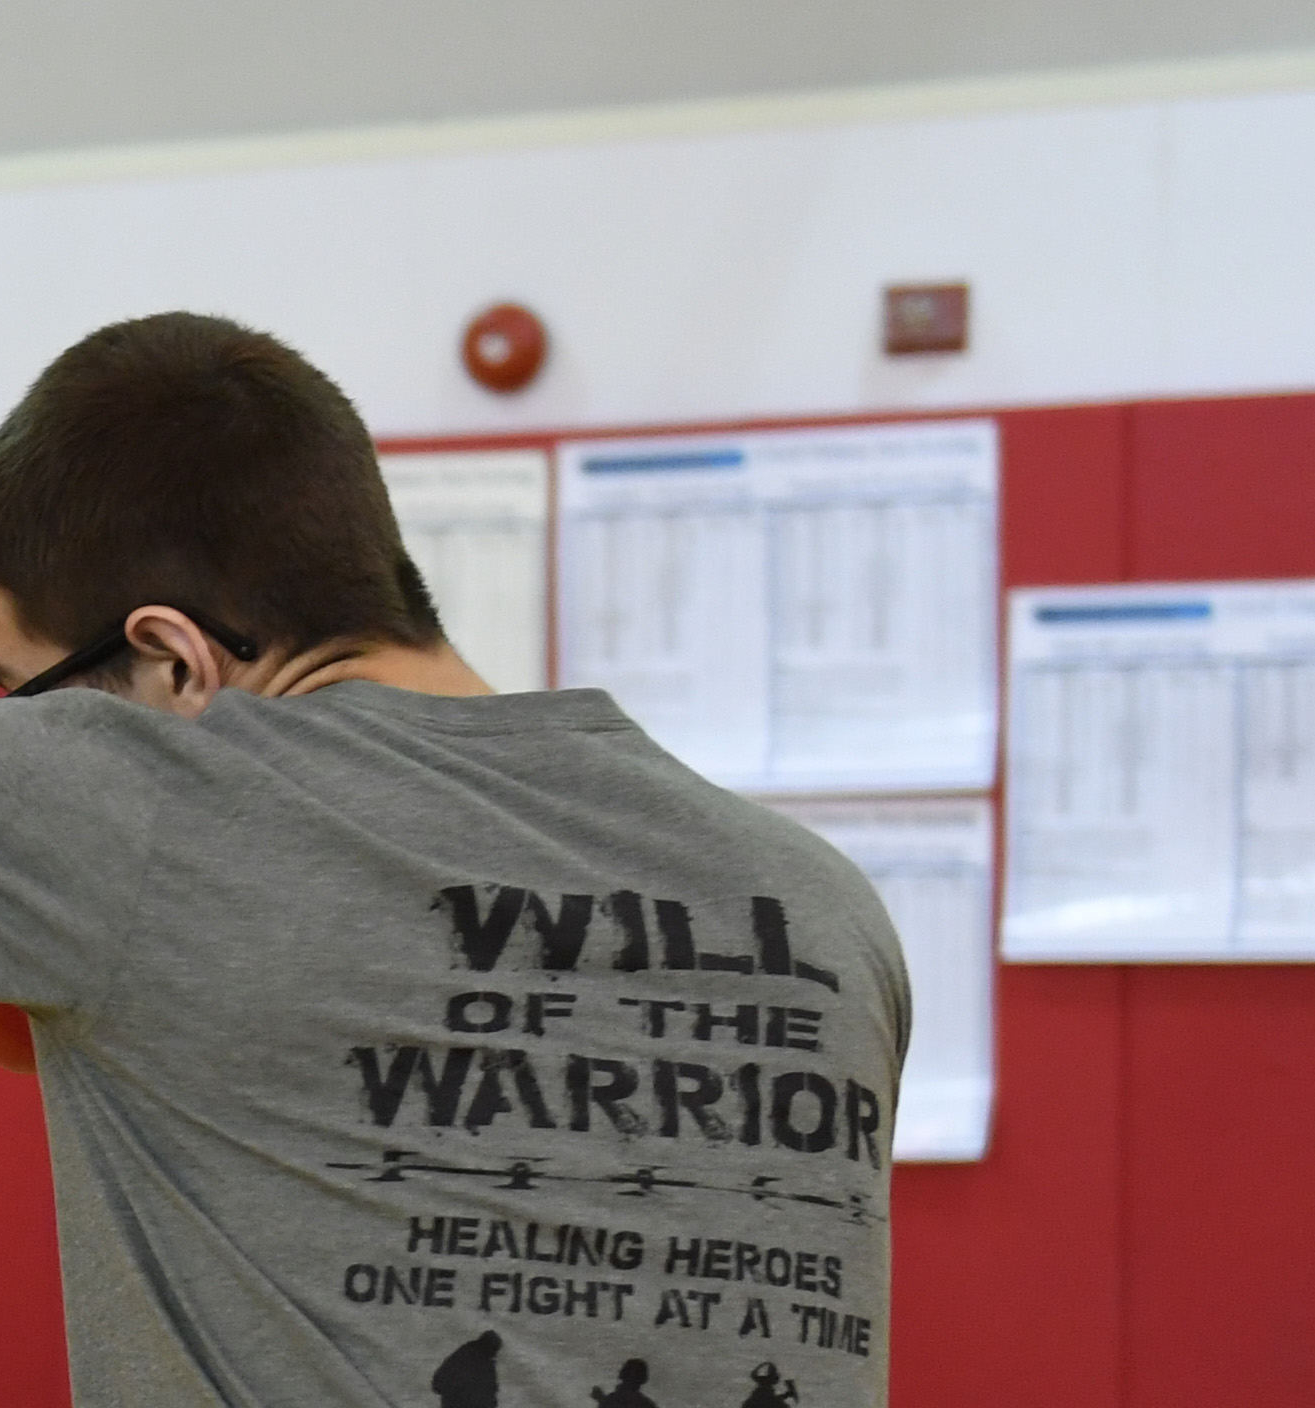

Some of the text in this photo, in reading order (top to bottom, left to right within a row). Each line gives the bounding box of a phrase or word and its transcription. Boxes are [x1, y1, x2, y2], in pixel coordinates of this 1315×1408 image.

[430, 881, 839, 993] WILL
[444, 992, 822, 1052] OF THE
[346, 1042, 881, 1171] WARRIOR
[406, 1216, 842, 1298] HEALING HEROES
[344, 1263, 871, 1357] ONE FIGHT AT A TIME
